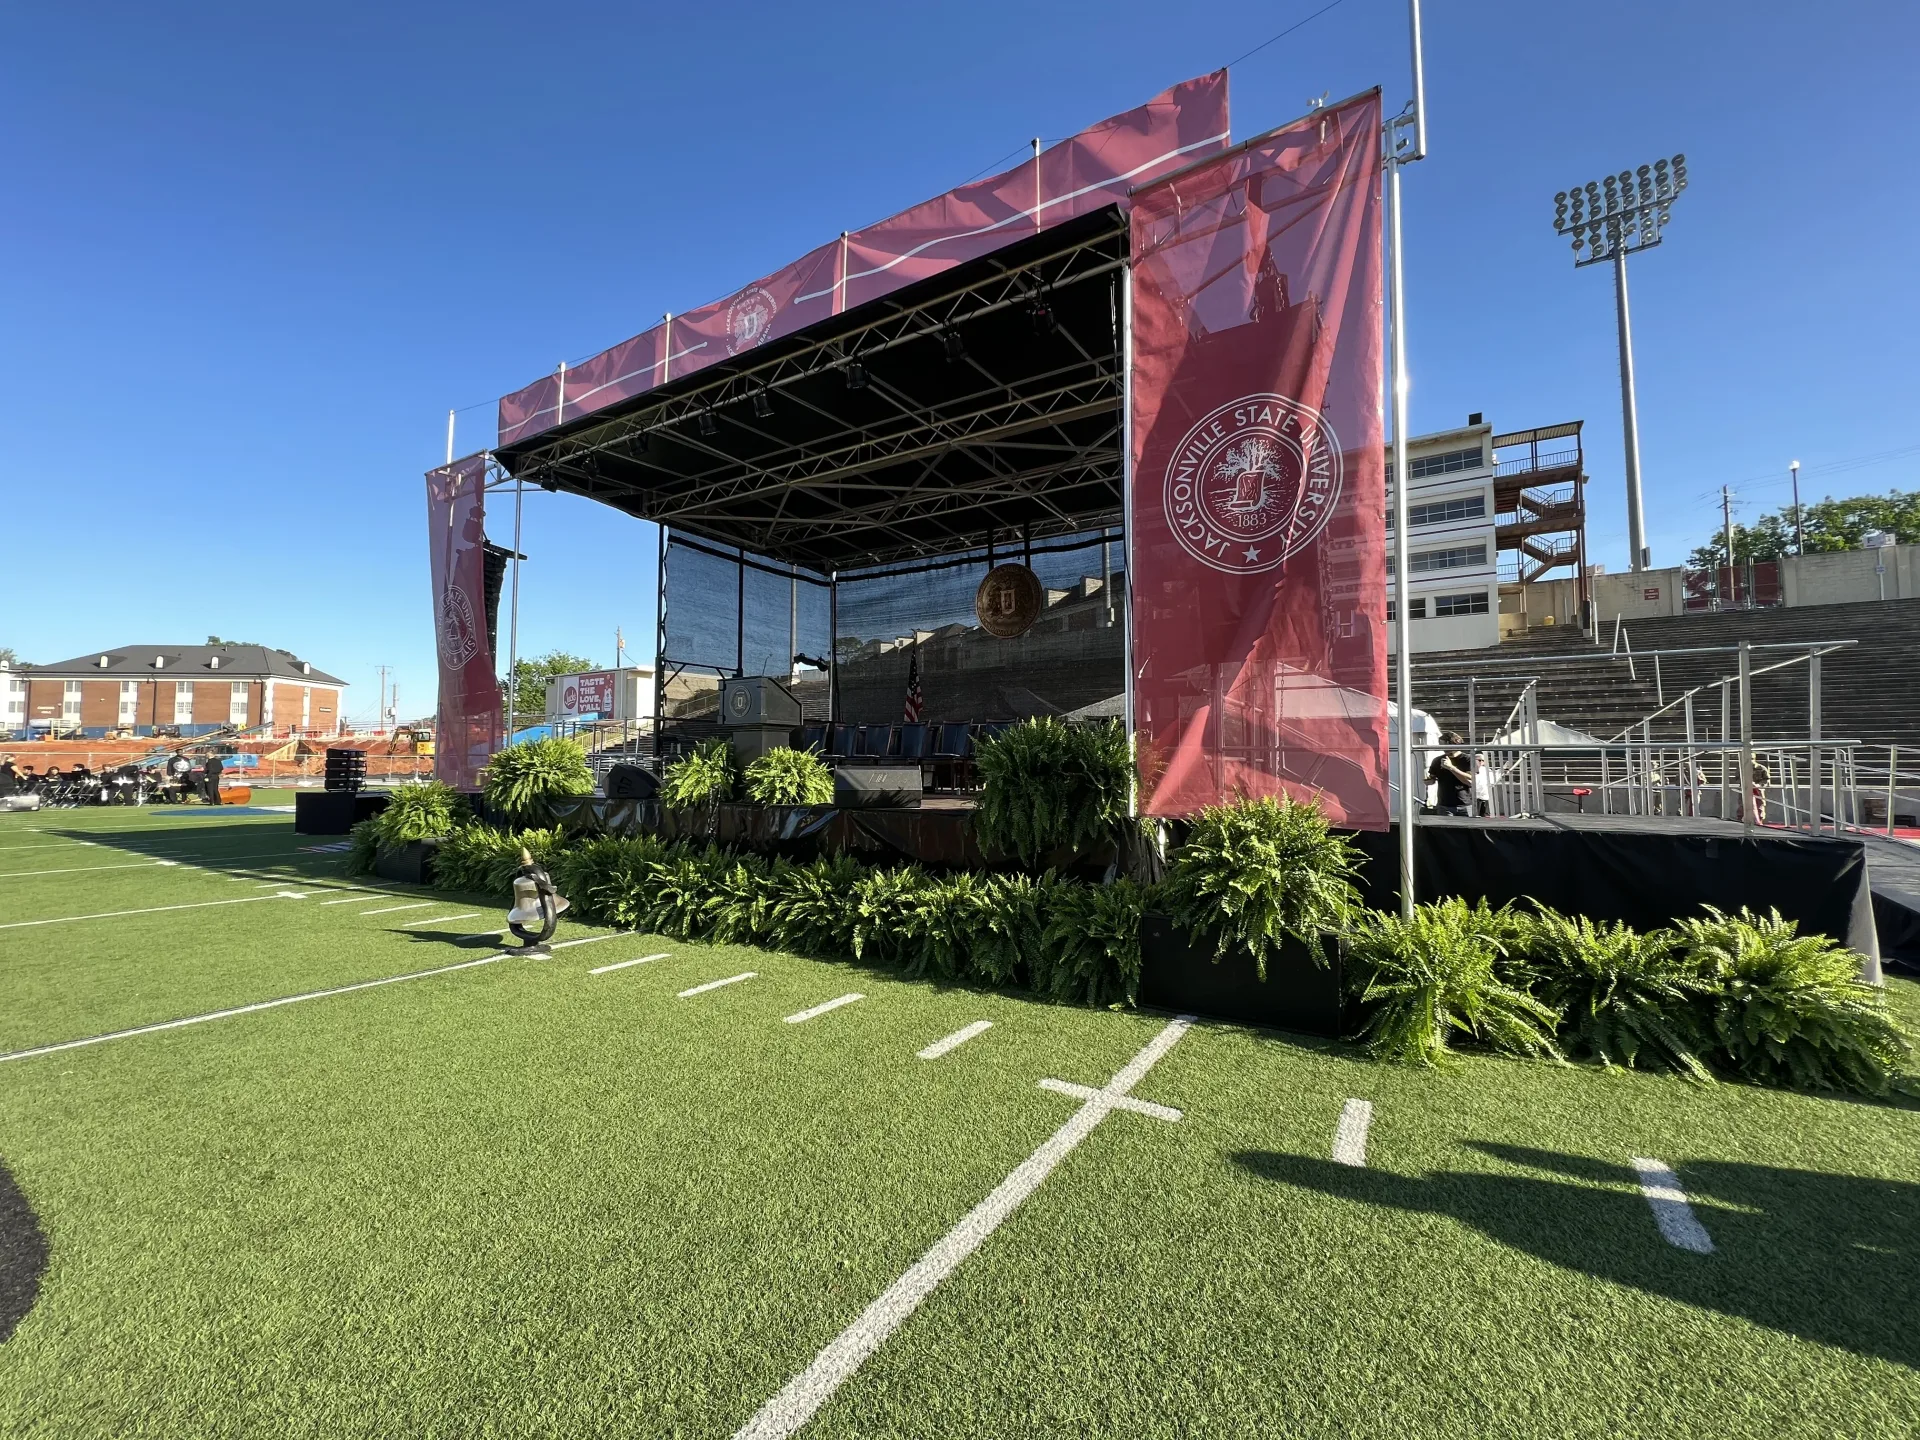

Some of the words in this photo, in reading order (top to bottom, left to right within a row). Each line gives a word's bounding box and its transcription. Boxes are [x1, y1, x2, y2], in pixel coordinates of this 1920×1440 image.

[1173, 420, 1230, 557] JACKSONVILLE
[1234, 405, 1298, 432] STATE
[1279, 423, 1331, 551] UNIVERSITY
[1237, 513, 1267, 528] 1883
[580, 678, 605, 687] TASTE
[580, 687, 596, 695] THE
[580, 704, 601, 712] Y'ALL
